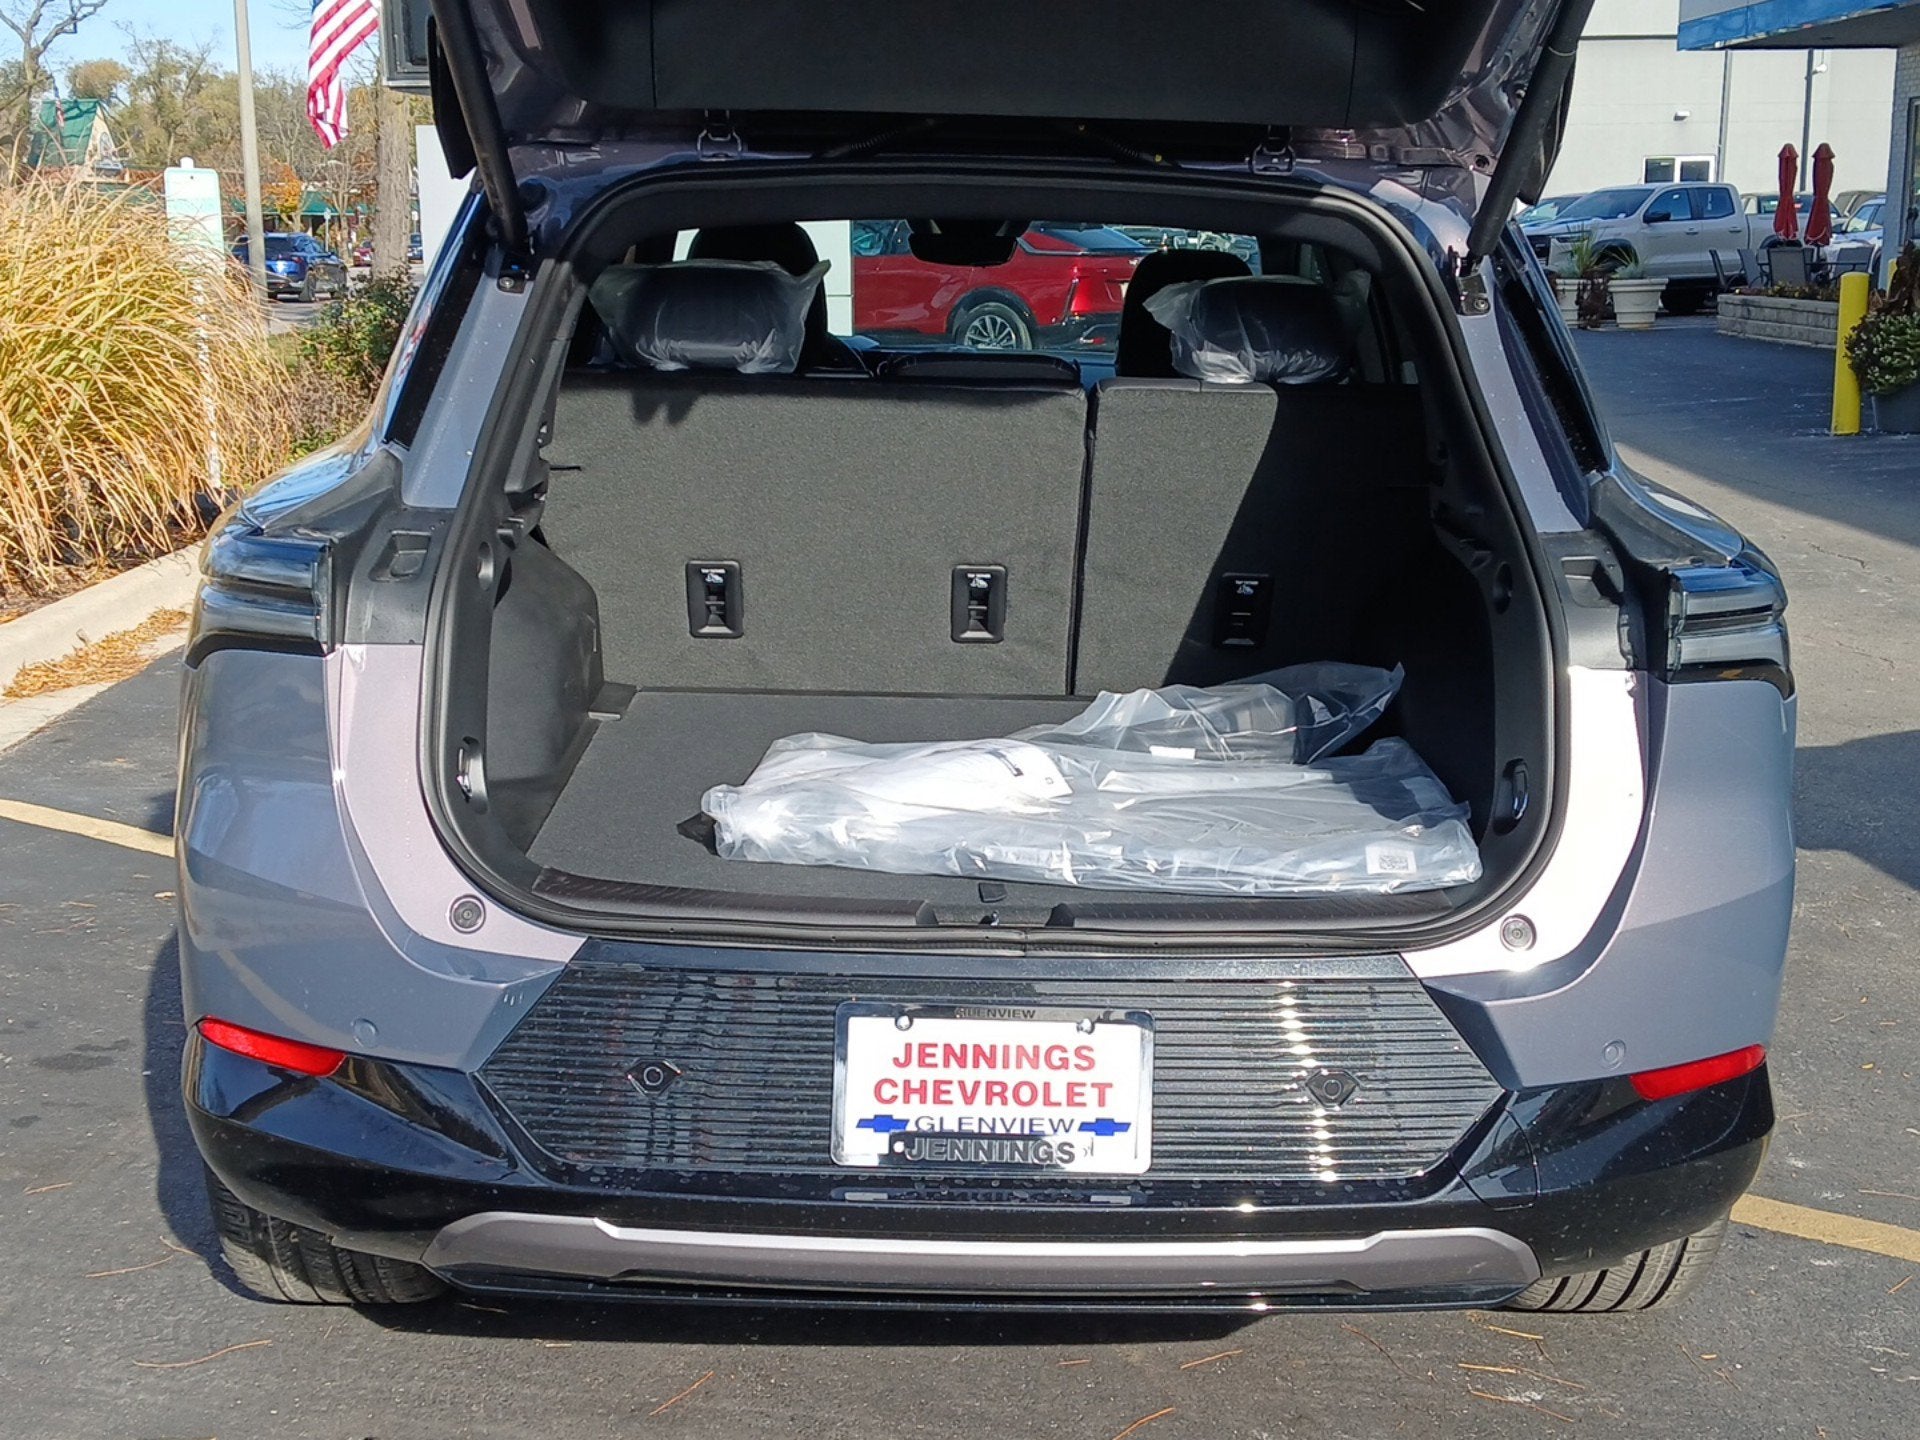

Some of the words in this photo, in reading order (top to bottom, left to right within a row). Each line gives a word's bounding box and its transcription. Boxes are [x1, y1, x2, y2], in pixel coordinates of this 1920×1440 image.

[954, 1007, 1036, 1019] GLENVIEW
[892, 1042, 1096, 1071] JENNINGS
[873, 1078, 1114, 1108] CHEVROLET
[915, 1115, 1075, 1136] GLENVIEW
[905, 1137, 1076, 1164] JENNINGS
